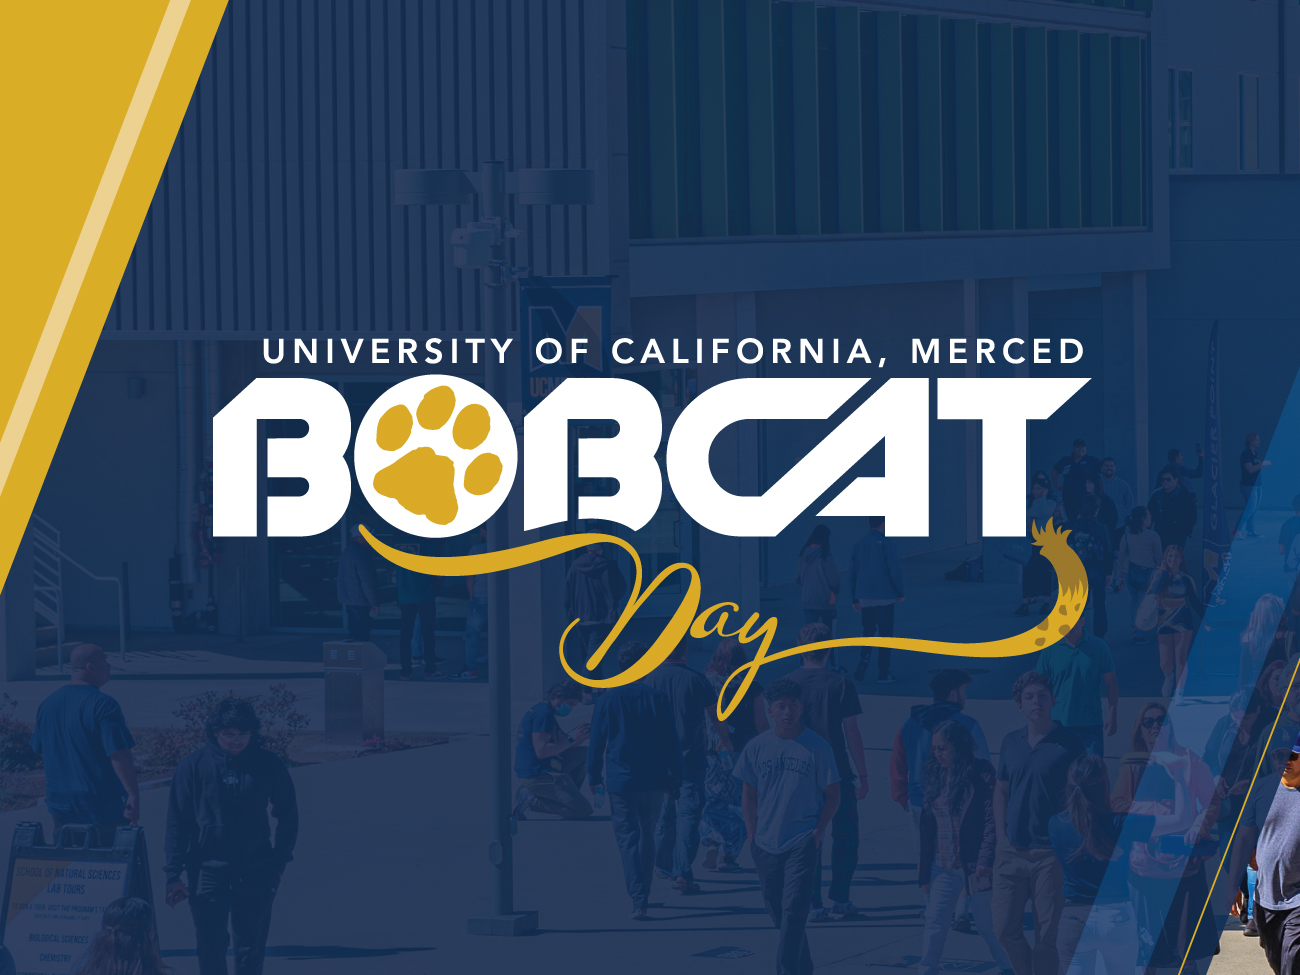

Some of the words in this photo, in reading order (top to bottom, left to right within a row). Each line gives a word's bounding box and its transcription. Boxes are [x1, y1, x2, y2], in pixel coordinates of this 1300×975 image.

[1209, 340, 1217, 420] POINT
[1210, 426, 1219, 531] GLACIER
[775, 756, 811, 777] ANGELES
[16, 866, 42, 877] SCHOOL
[45, 868, 54, 877] OF
[55, 868, 85, 879] NATURAL
[88, 869, 121, 880] SCIENCES
[47, 883, 60, 893] LAB
[63, 884, 85, 894] TOURS
[61, 904, 70, 912] THE
[71, 905, 98, 913] PROGRAM'S
[29, 933, 60, 943] BIOLOGICAL
[61, 935, 89, 944] SCIENCES
[39, 953, 73, 962] CHEMISTRY
